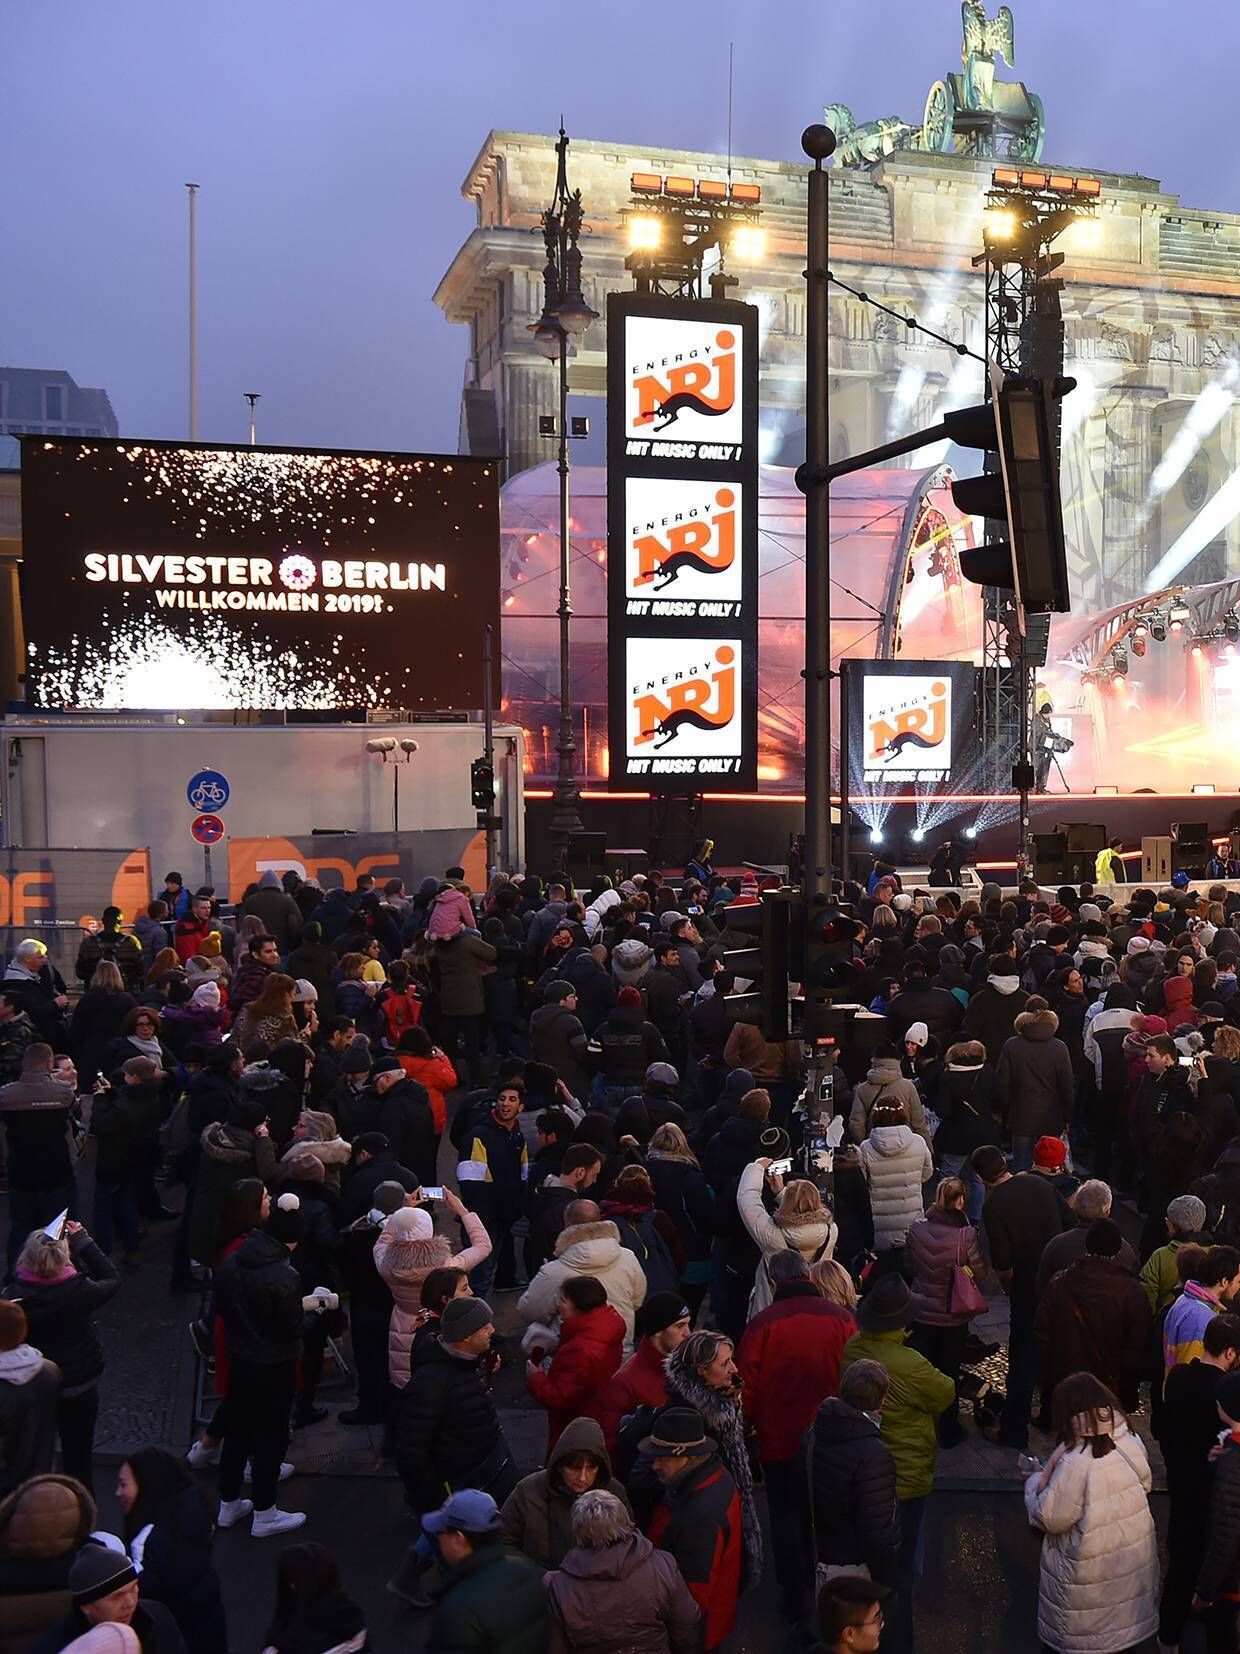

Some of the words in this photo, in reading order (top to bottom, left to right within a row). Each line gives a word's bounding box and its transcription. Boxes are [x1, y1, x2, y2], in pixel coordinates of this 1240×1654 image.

[632, 345, 711, 374] ENERGY
[625, 441, 650, 456] HIT
[651, 442, 696, 459] MUSIC
[698, 444, 734, 460] ONLY
[632, 504, 711, 534] ENERGY
[83, 552, 273, 586] SILVESTER
[321, 559, 446, 591] BERLIN
[155, 589, 319, 612] WILLKOMMEN
[626, 600, 650, 615] HIT
[651, 601, 697, 617] MUSIC
[698, 602, 734, 617] ONLY
[632, 662, 711, 694] ENERGY
[626, 758, 651, 774] HIT
[652, 758, 697, 774] MUSIC
[698, 759, 734, 774] ONLY
